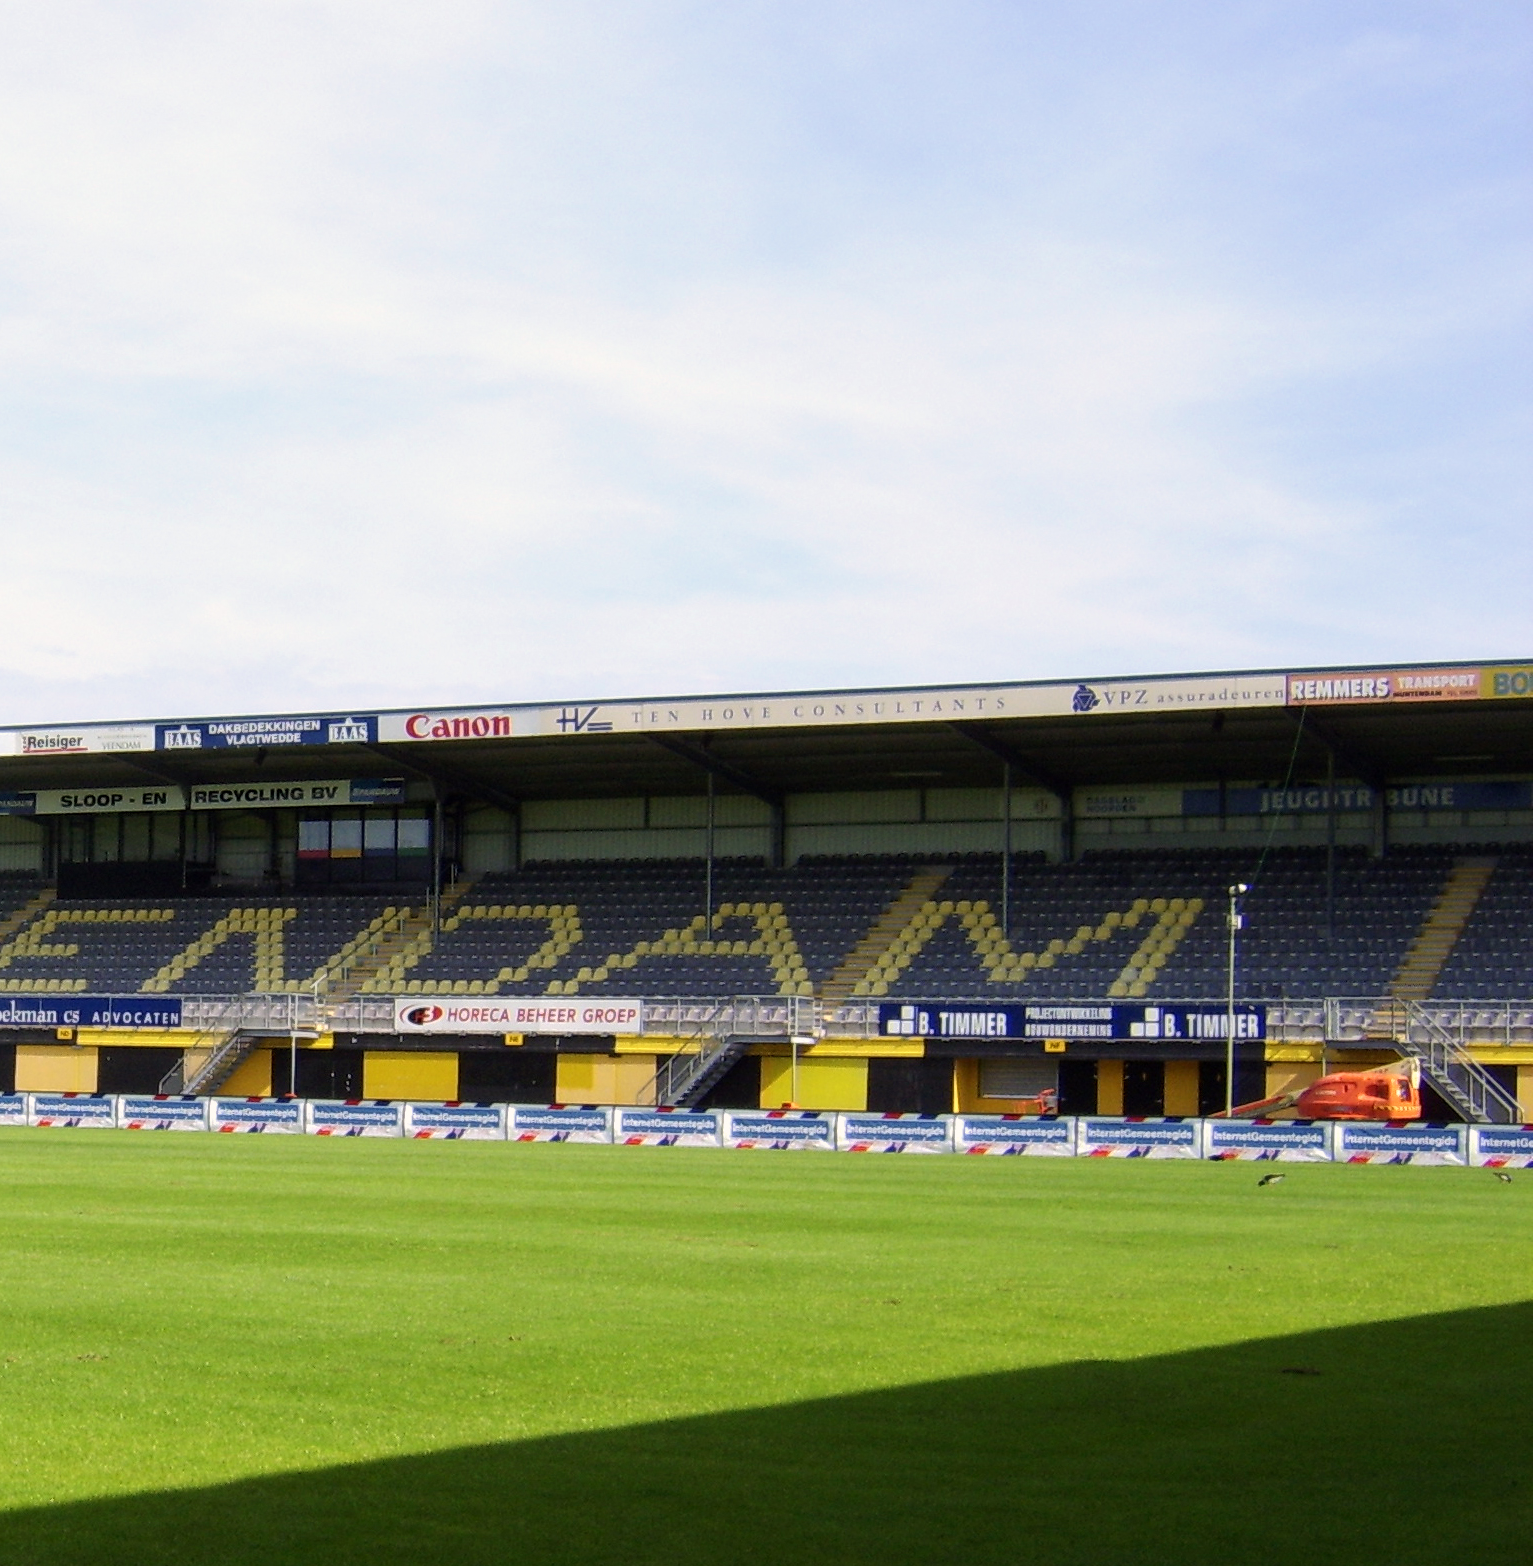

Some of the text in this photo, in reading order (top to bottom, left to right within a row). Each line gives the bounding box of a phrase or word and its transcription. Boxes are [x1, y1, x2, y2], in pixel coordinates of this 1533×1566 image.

[1291, 673, 1476, 700] REMMERS TRANSPORT
[1493, 671, 1533, 695] BO
[1103, 688, 1284, 705] VPZ assuradeuren
[632, 697, 1005, 724] TEN HOVE CONSULTANTS
[209, 720, 321, 735] DAKBEDEKKINGEN
[405, 714, 511, 740] Canon
[27, 734, 84, 750] Reisiger
[226, 733, 302, 746] VLAGTWEDDE
[61, 793, 123, 808] SLOOP
[142, 793, 168, 805] EN
[194, 787, 305, 804] RECYCLING
[311, 786, 338, 800] BV
[63, 1009, 80, 1024] cs
[92, 1011, 179, 1025] ADVOCATEN
[448, 1007, 637, 1024] HORECA BEHEER GROEP
[918, 1011, 1007, 1036] B. TIMMER
[1164, 1013, 1259, 1038] B. TIMMER
[217, 1107, 297, 1119] InternetGemeentegids
[314, 1109, 396, 1122] InternetGemeentegids
[515, 1114, 606, 1127] InternetGemeentegids
[622, 1117, 715, 1130] InternetGemeentegids
[731, 1122, 828, 1136] InternetGemeentegids
[846, 1123, 945, 1138] InternetGemeentegids
[964, 1125, 1067, 1140] InternetGemeentegids
[1087, 1127, 1193, 1142] InternetGemeentegids
[1213, 1129, 1323, 1145] InternetGemeentegids
[1344, 1132, 1457, 1148] InternetGemeentegids
